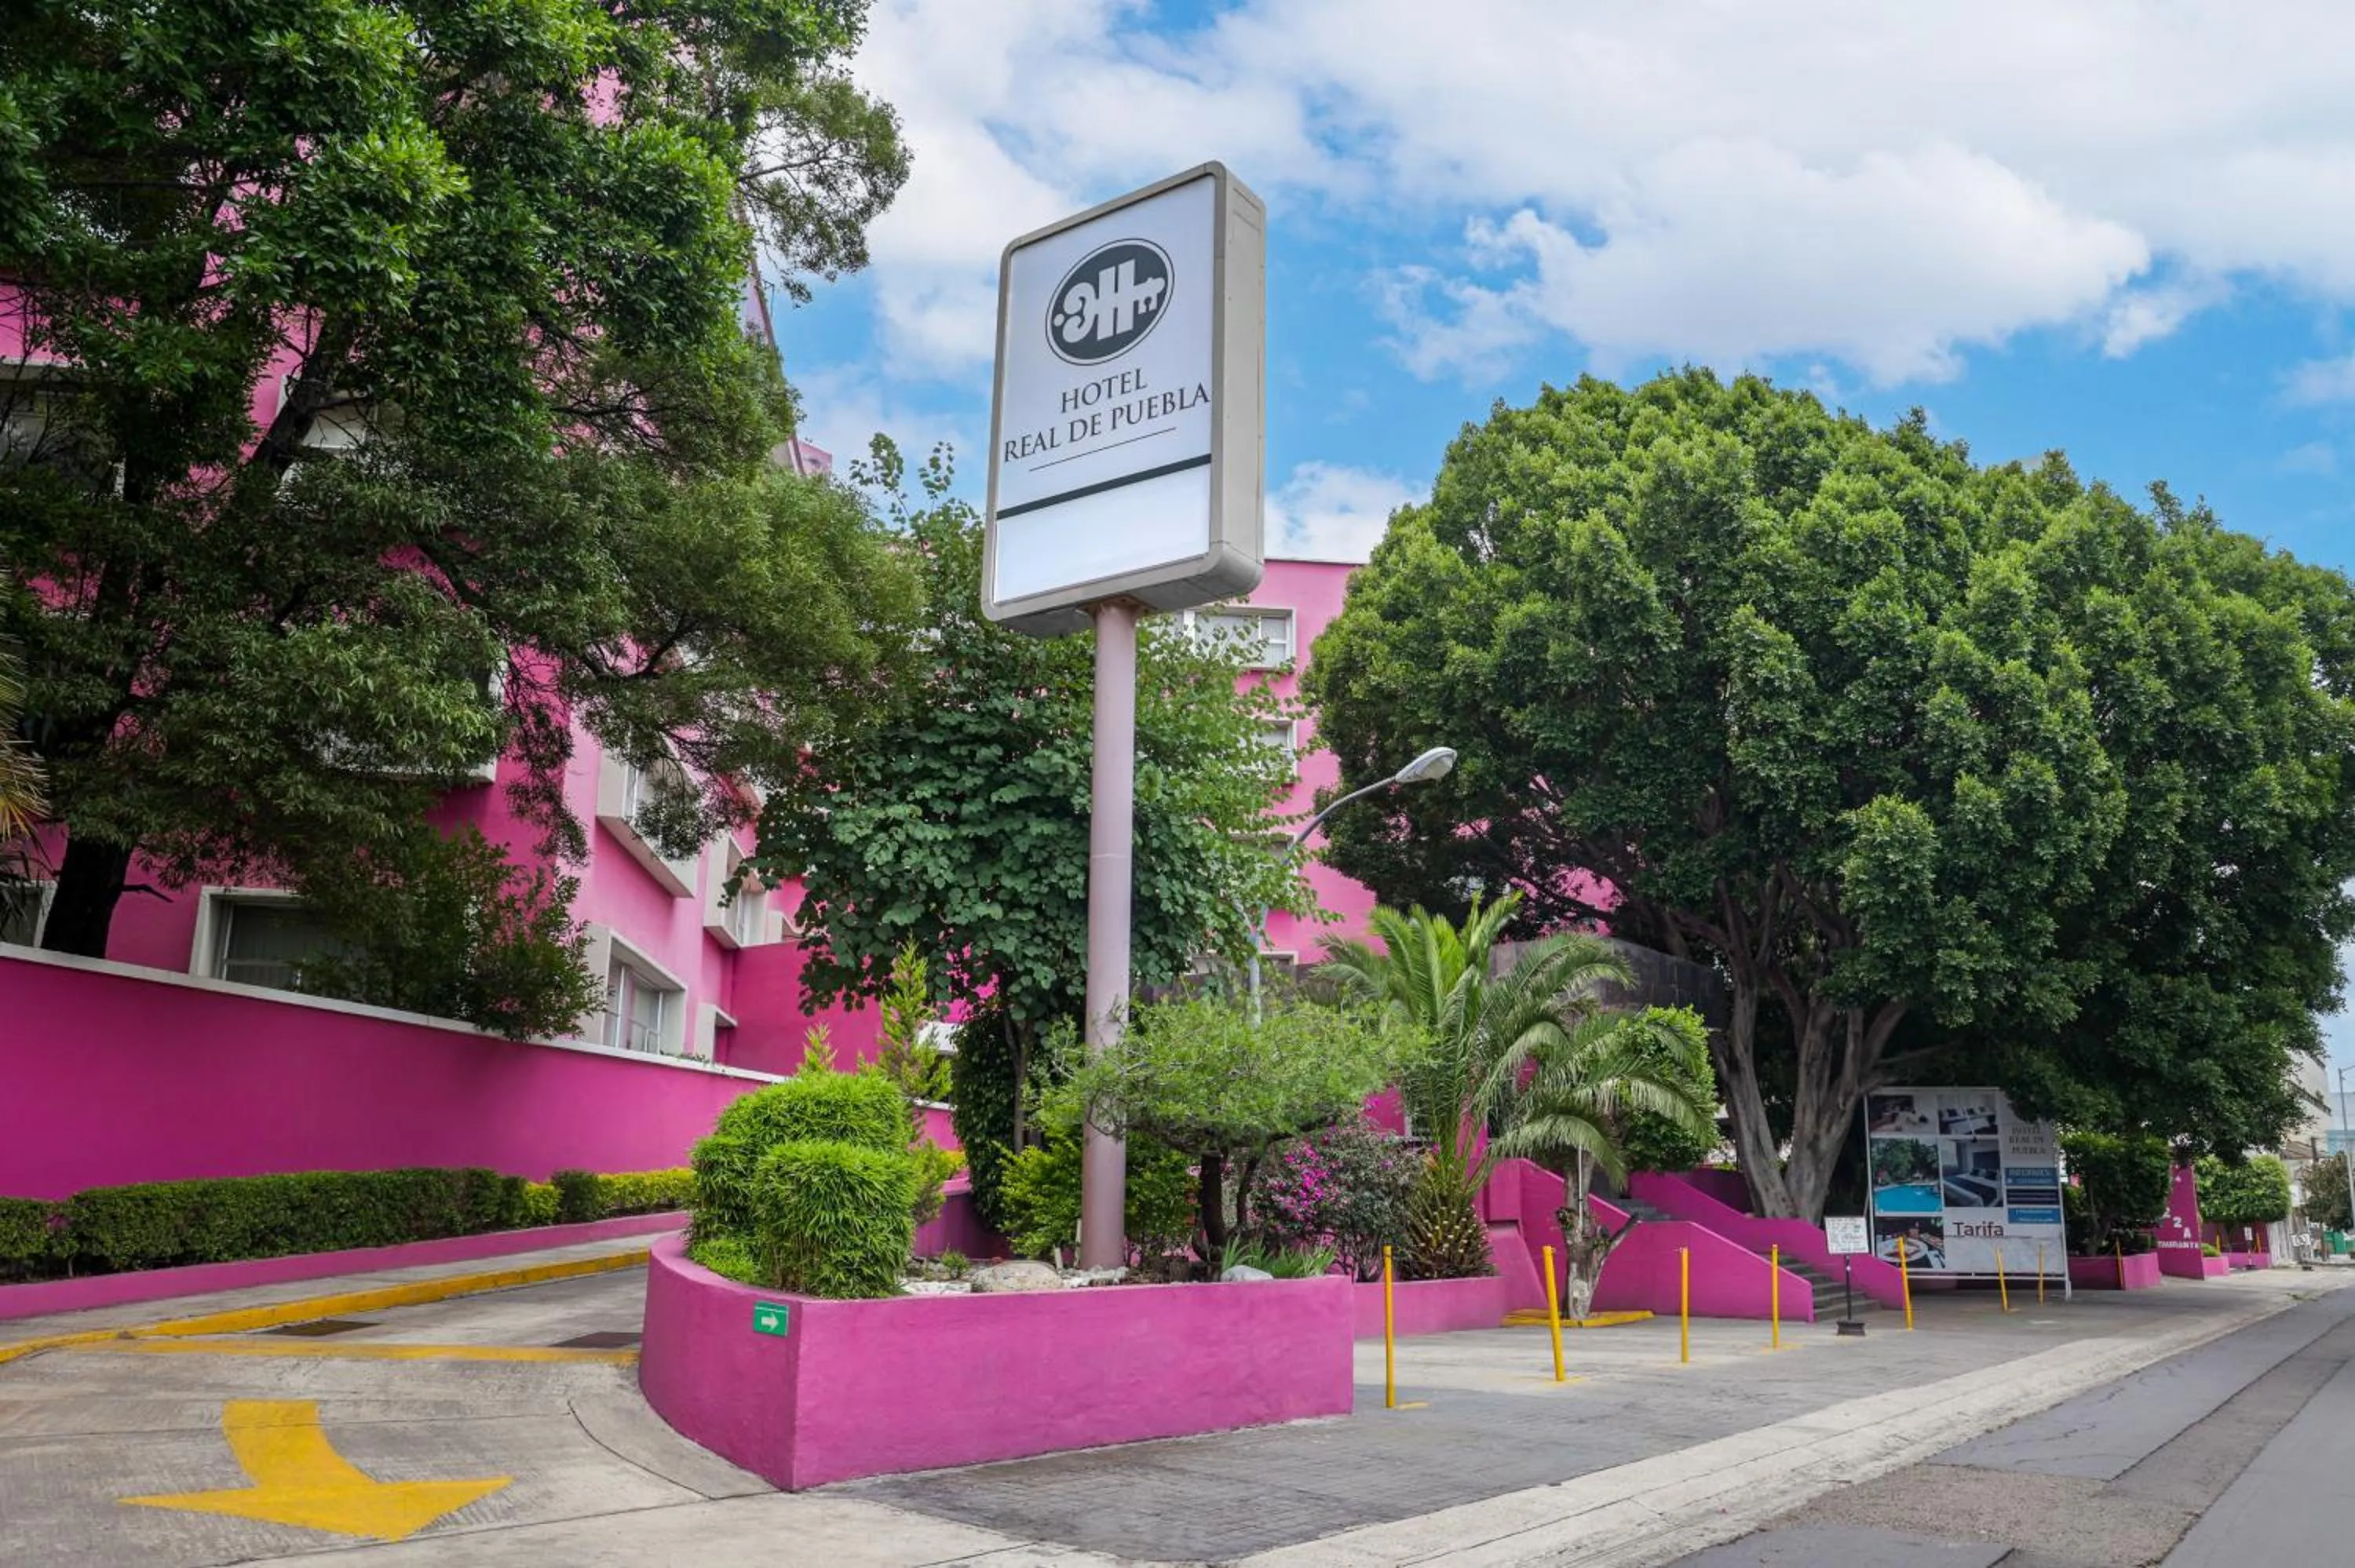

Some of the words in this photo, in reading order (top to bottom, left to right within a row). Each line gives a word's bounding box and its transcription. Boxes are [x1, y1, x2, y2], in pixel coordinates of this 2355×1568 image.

[1061, 368, 1147, 414] HOTEL
[1004, 427, 1061, 463] REAL
[1068, 412, 1102, 443] DE
[1111, 381, 1210, 430] PUEBLA
[1952, 1221, 2004, 1237] Tarifa
